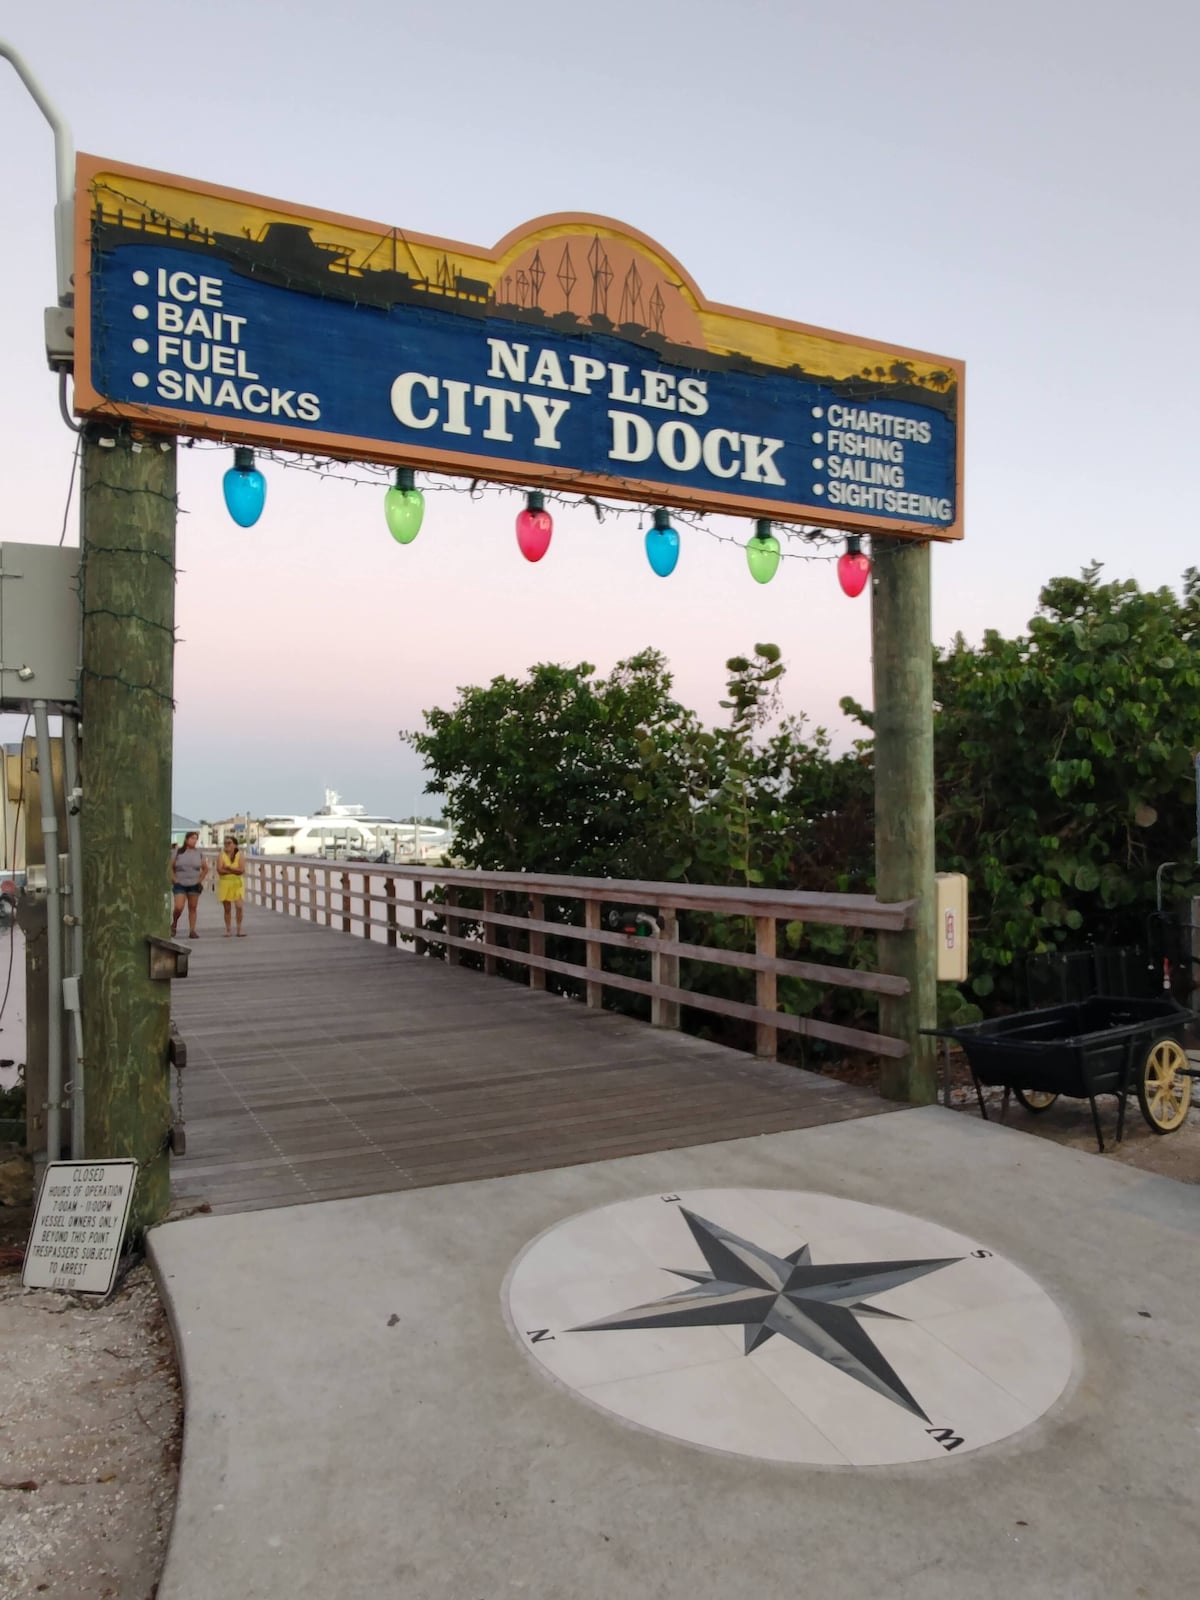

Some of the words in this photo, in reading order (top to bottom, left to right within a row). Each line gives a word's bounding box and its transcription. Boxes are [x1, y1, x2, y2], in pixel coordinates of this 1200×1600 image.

[157, 268, 223, 307] ICE
[157, 301, 247, 344] BAIT
[157, 335, 259, 380] FUEL
[486, 338, 709, 416] NAPLES
[156, 369, 321, 421] SNACKS
[390, 372, 570, 449] CITY
[608, 410, 786, 486] DOCK
[827, 404, 931, 443] CHARTERS
[827, 430, 903, 463] FISHING
[827, 455, 904, 488] SAILING
[827, 481, 952, 521] SIGHTSEEING
[48, 1186, 70, 1197] HOURS
[73, 1186, 82, 1197] OF
[84, 1185, 123, 1197] OPERATION
[73, 1168, 104, 1182] CLOSED
[41, 1216, 65, 1227] VESSEL
[68, 1216, 96, 1228] OWNERS
[99, 1216, 118, 1229] ONLY
[41, 1231, 69, 1242] BEYOND
[71, 1231, 87, 1243] THIS
[88, 1231, 110, 1243] POINT
[33, 1245, 79, 1259] TRESPASSERS
[81, 1247, 114, 1260] SUBJECT
[49, 1262, 58, 1273] TO
[60, 1262, 87, 1275] ARREST
[526, 1328, 556, 1344] N
[924, 1425, 965, 1451] W
